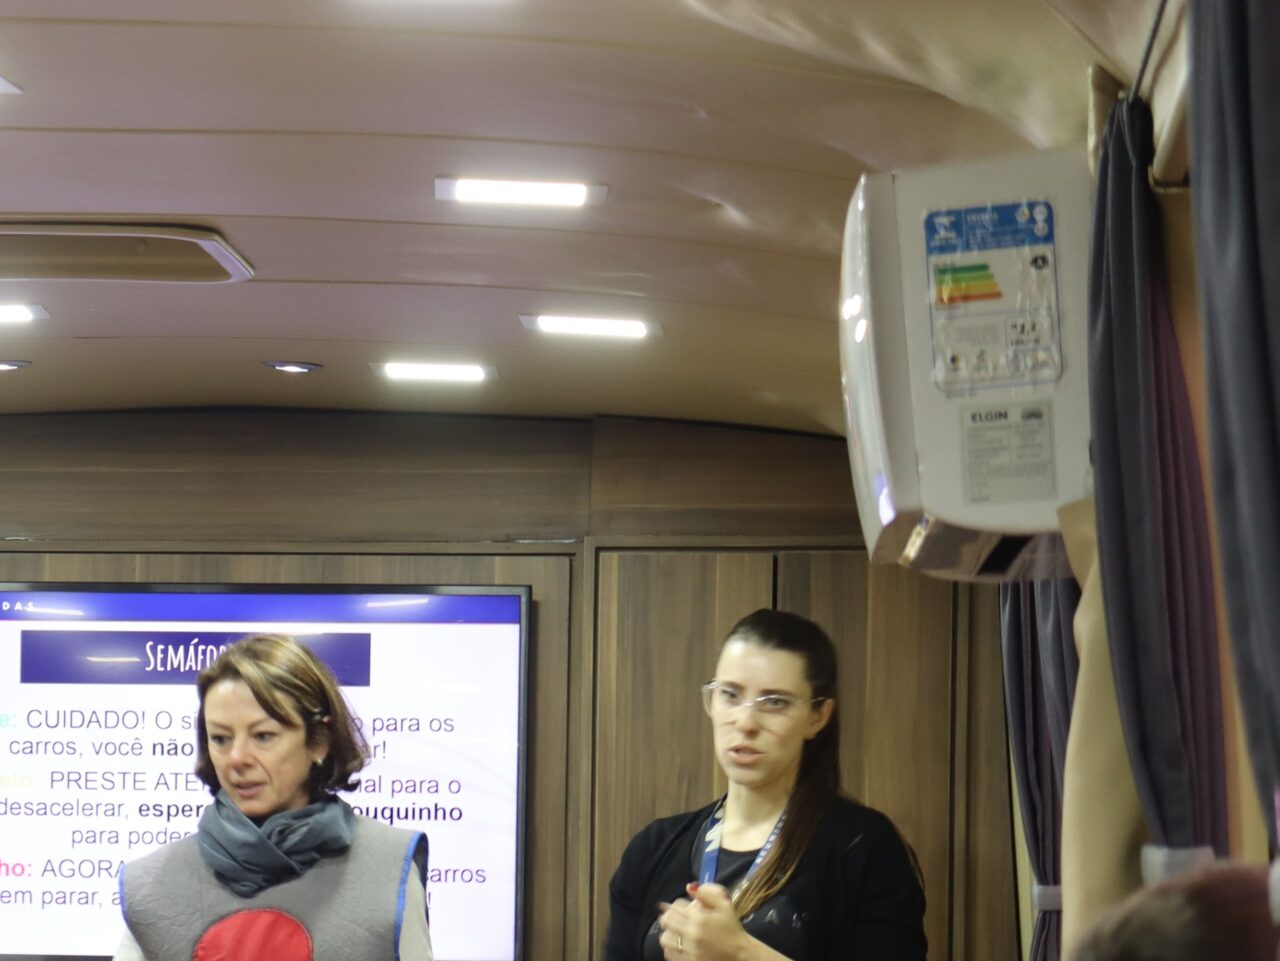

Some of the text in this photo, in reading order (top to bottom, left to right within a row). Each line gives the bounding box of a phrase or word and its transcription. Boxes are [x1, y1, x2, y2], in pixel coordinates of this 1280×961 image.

[26, 709, 145, 730] CUIDADO!
[155, 710, 172, 730] O
[372, 716, 420, 736] para
[429, 717, 455, 732] os
[9, 737, 194, 758] carros, você não
[50, 771, 147, 790] PRESTE
[391, 779, 439, 798] para
[448, 780, 461, 794] o
[138, 803, 204, 822] esper
[352, 803, 463, 825] ouquinho
[71, 829, 119, 848] para
[41, 890, 103, 909] parar,
